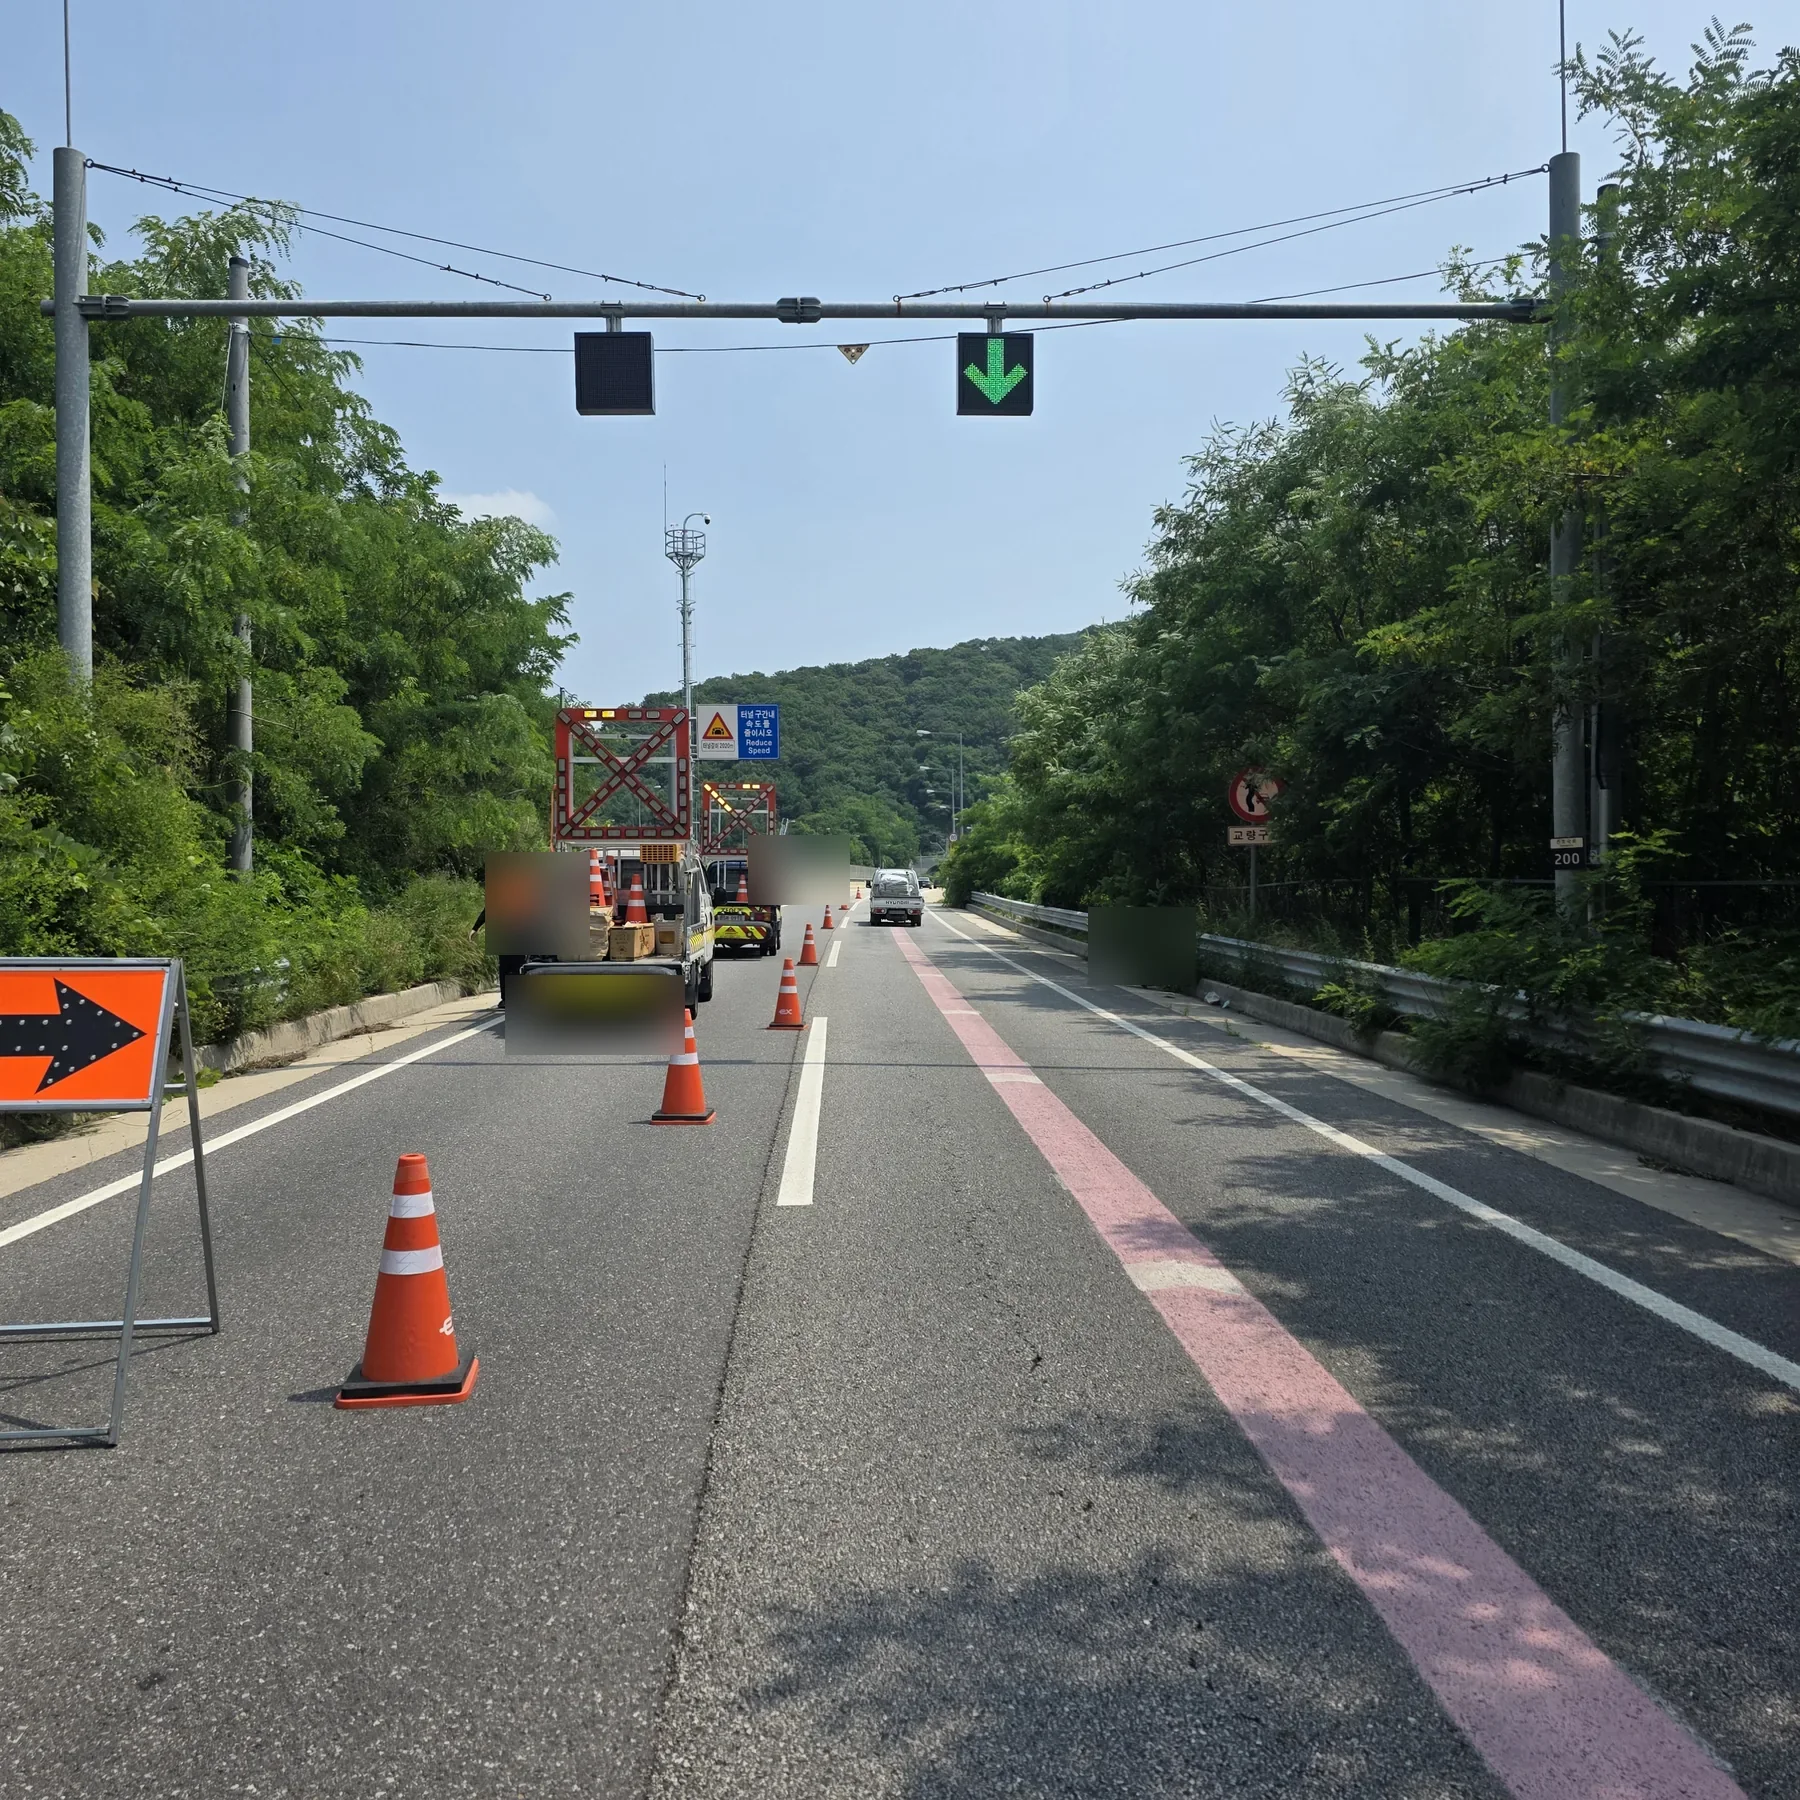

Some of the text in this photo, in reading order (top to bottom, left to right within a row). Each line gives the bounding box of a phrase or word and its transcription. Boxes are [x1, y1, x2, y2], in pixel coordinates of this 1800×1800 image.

[740, 710, 775, 719] 터널 구간내
[745, 720, 770, 728] 속도를
[744, 729, 773, 737] 줄이시오
[748, 747, 771, 755] Speed
[1233, 830, 1269, 841] 교량구
[1554, 852, 1580, 865] 200
[439, 1316, 454, 1336] e
